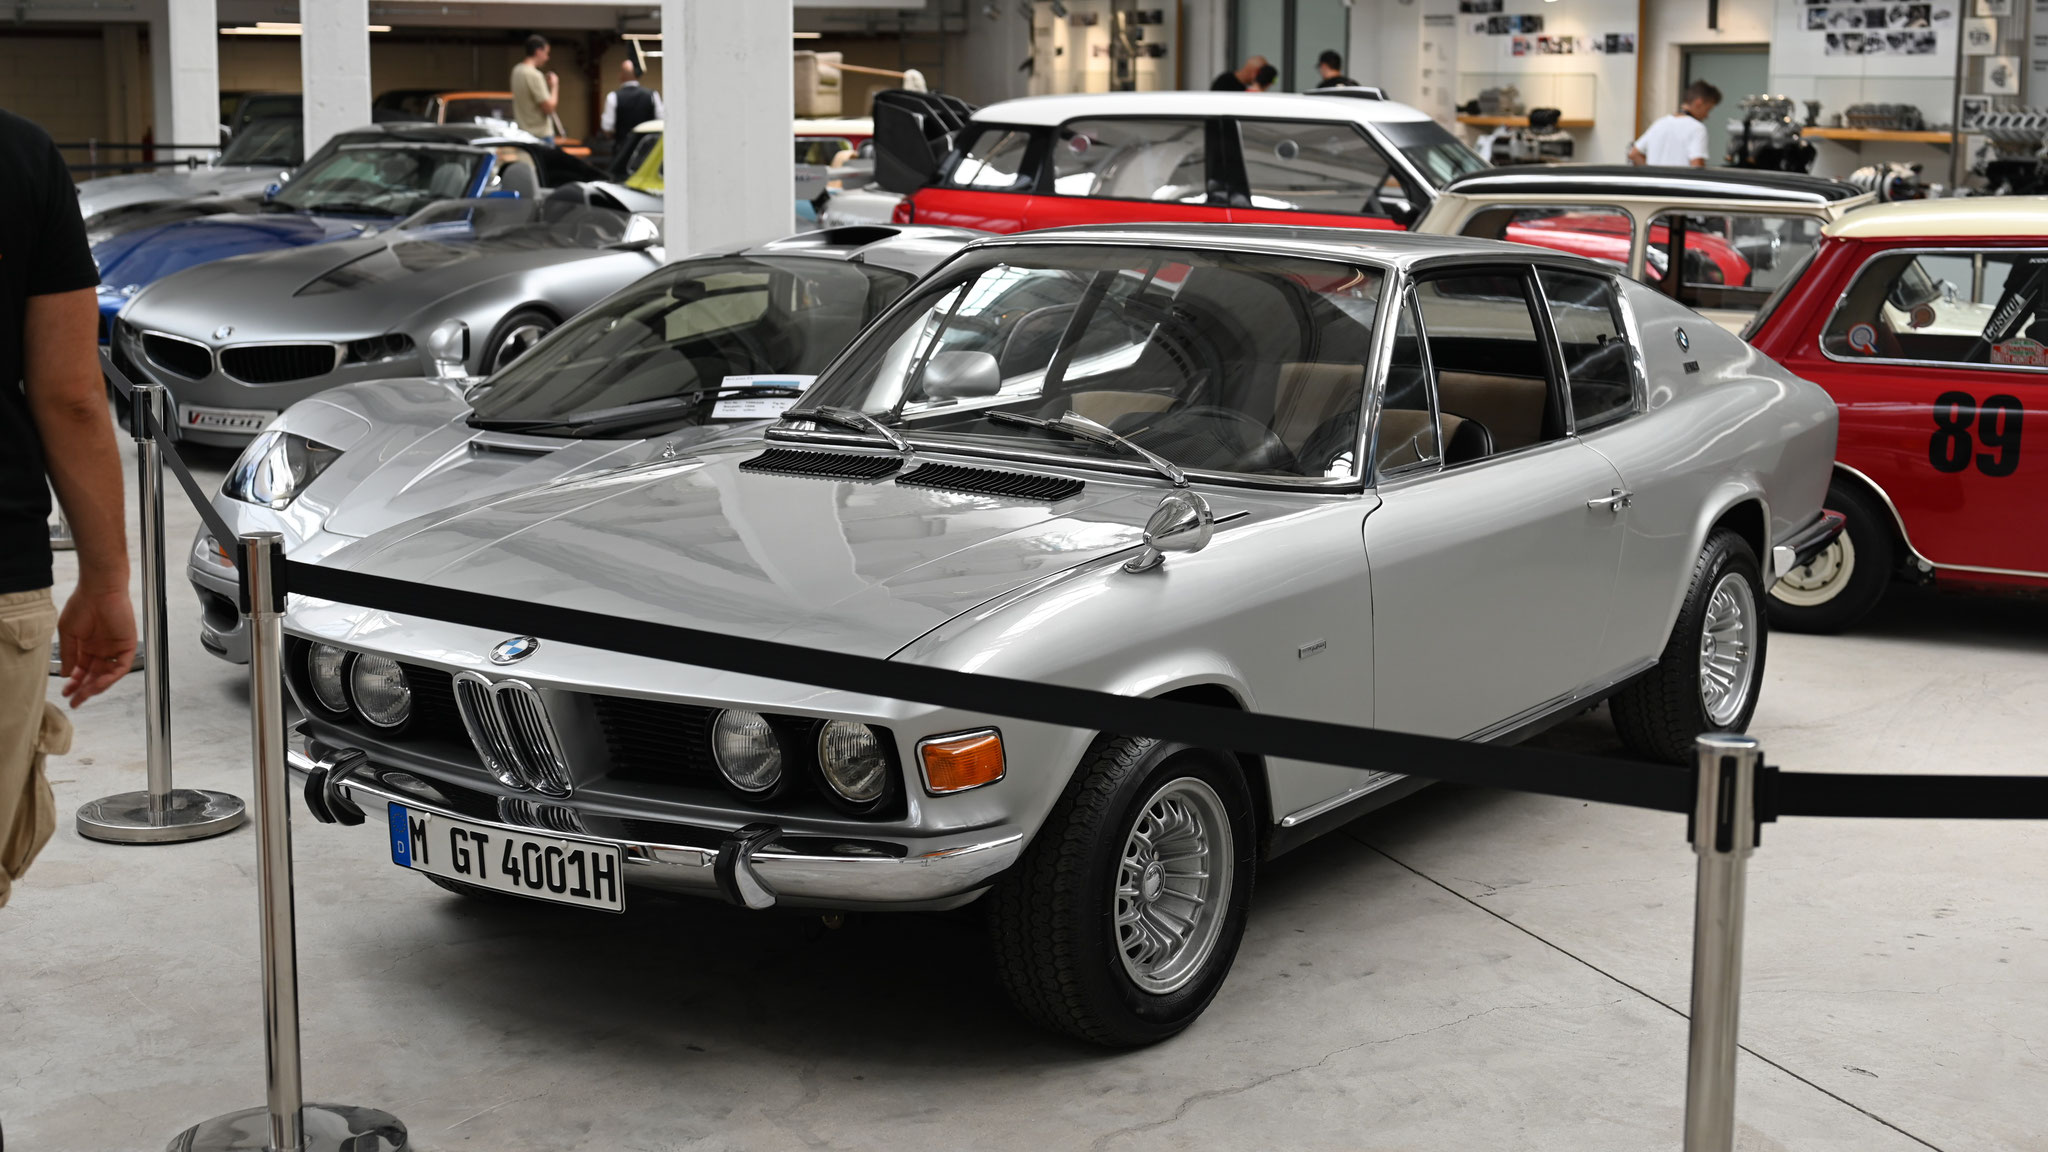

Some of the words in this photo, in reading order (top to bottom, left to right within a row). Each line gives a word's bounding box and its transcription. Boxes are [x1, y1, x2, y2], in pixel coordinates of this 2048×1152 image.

[1985, 293, 2020, 339] Castrol
[1929, 391, 2023, 477] 89
[397, 840, 405, 854] D
[409, 815, 429, 865] M
[450, 827, 489, 880] GT
[502, 838, 617, 903] 4001H
